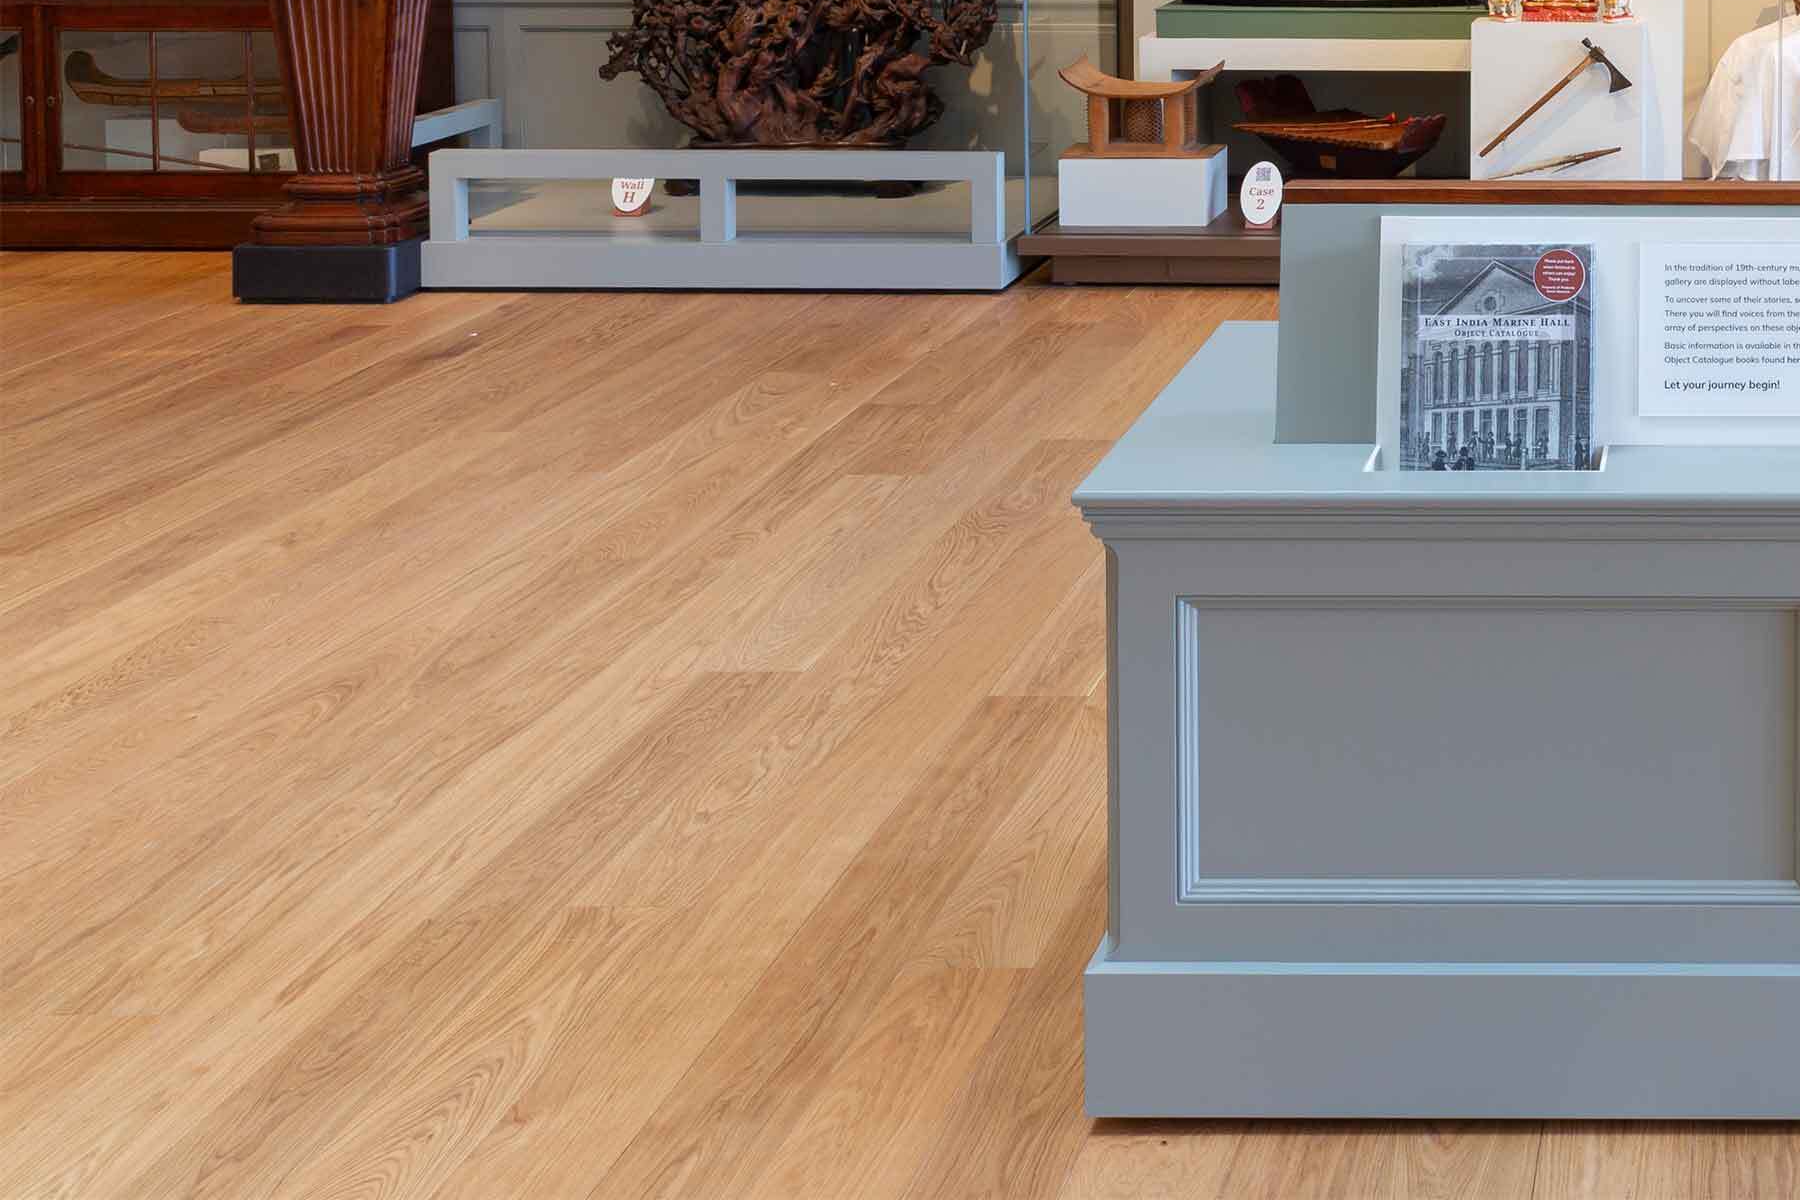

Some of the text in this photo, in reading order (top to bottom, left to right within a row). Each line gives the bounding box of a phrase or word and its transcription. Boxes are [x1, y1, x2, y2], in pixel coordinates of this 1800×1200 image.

[620, 181, 644, 190] Wall
[1249, 187, 1274, 196] Case
[623, 192, 635, 203] H
[1256, 198, 1265, 210] 2
[1665, 264, 1672, 272] In
[1674, 264, 1687, 272] the
[1689, 264, 1723, 272] tradition
[1725, 264, 1734, 272] of
[1736, 264, 1787, 272] 19th-century
[1665, 278, 1691, 287] gallery
[1694, 278, 1707, 287] are
[1708, 278, 1747, 287] displayed
[1750, 278, 1780, 287] without
[1665, 296, 1673, 304] To
[1676, 296, 1708, 304] uncover
[1710, 296, 1731, 304] some
[1733, 296, 1742, 304] of
[1743, 296, 1762, 304] their
[1665, 310, 1687, 318] There
[1689, 310, 1704, 318] you
[1706, 310, 1720, 318] will
[1722, 310, 1737, 318] find
[1740, 310, 1764, 318] voices
[1766, 310, 1785, 318] from
[1786, 310, 1800, 318] the
[1425, 318, 1570, 327] EAST INDIA MARINE HALL
[1664, 324, 1685, 332] array
[1688, 324, 1696, 332] of
[1698, 324, 1748, 332] perspectives
[1750, 324, 1760, 332] on
[1762, 324, 1784, 332] these
[1664, 342, 1686, 350] Basic
[1688, 342, 1734, 350] information
[1736, 342, 1743, 350] is
[1745, 342, 1781, 350] available
[1784, 342, 1791, 350] in
[1664, 356, 1690, 364] Object
[1692, 356, 1733, 364] Catalogue
[1736, 356, 1759, 364] books
[1761, 356, 1785, 364] found
[1664, 380, 1780, 391] Let your journey begin!
